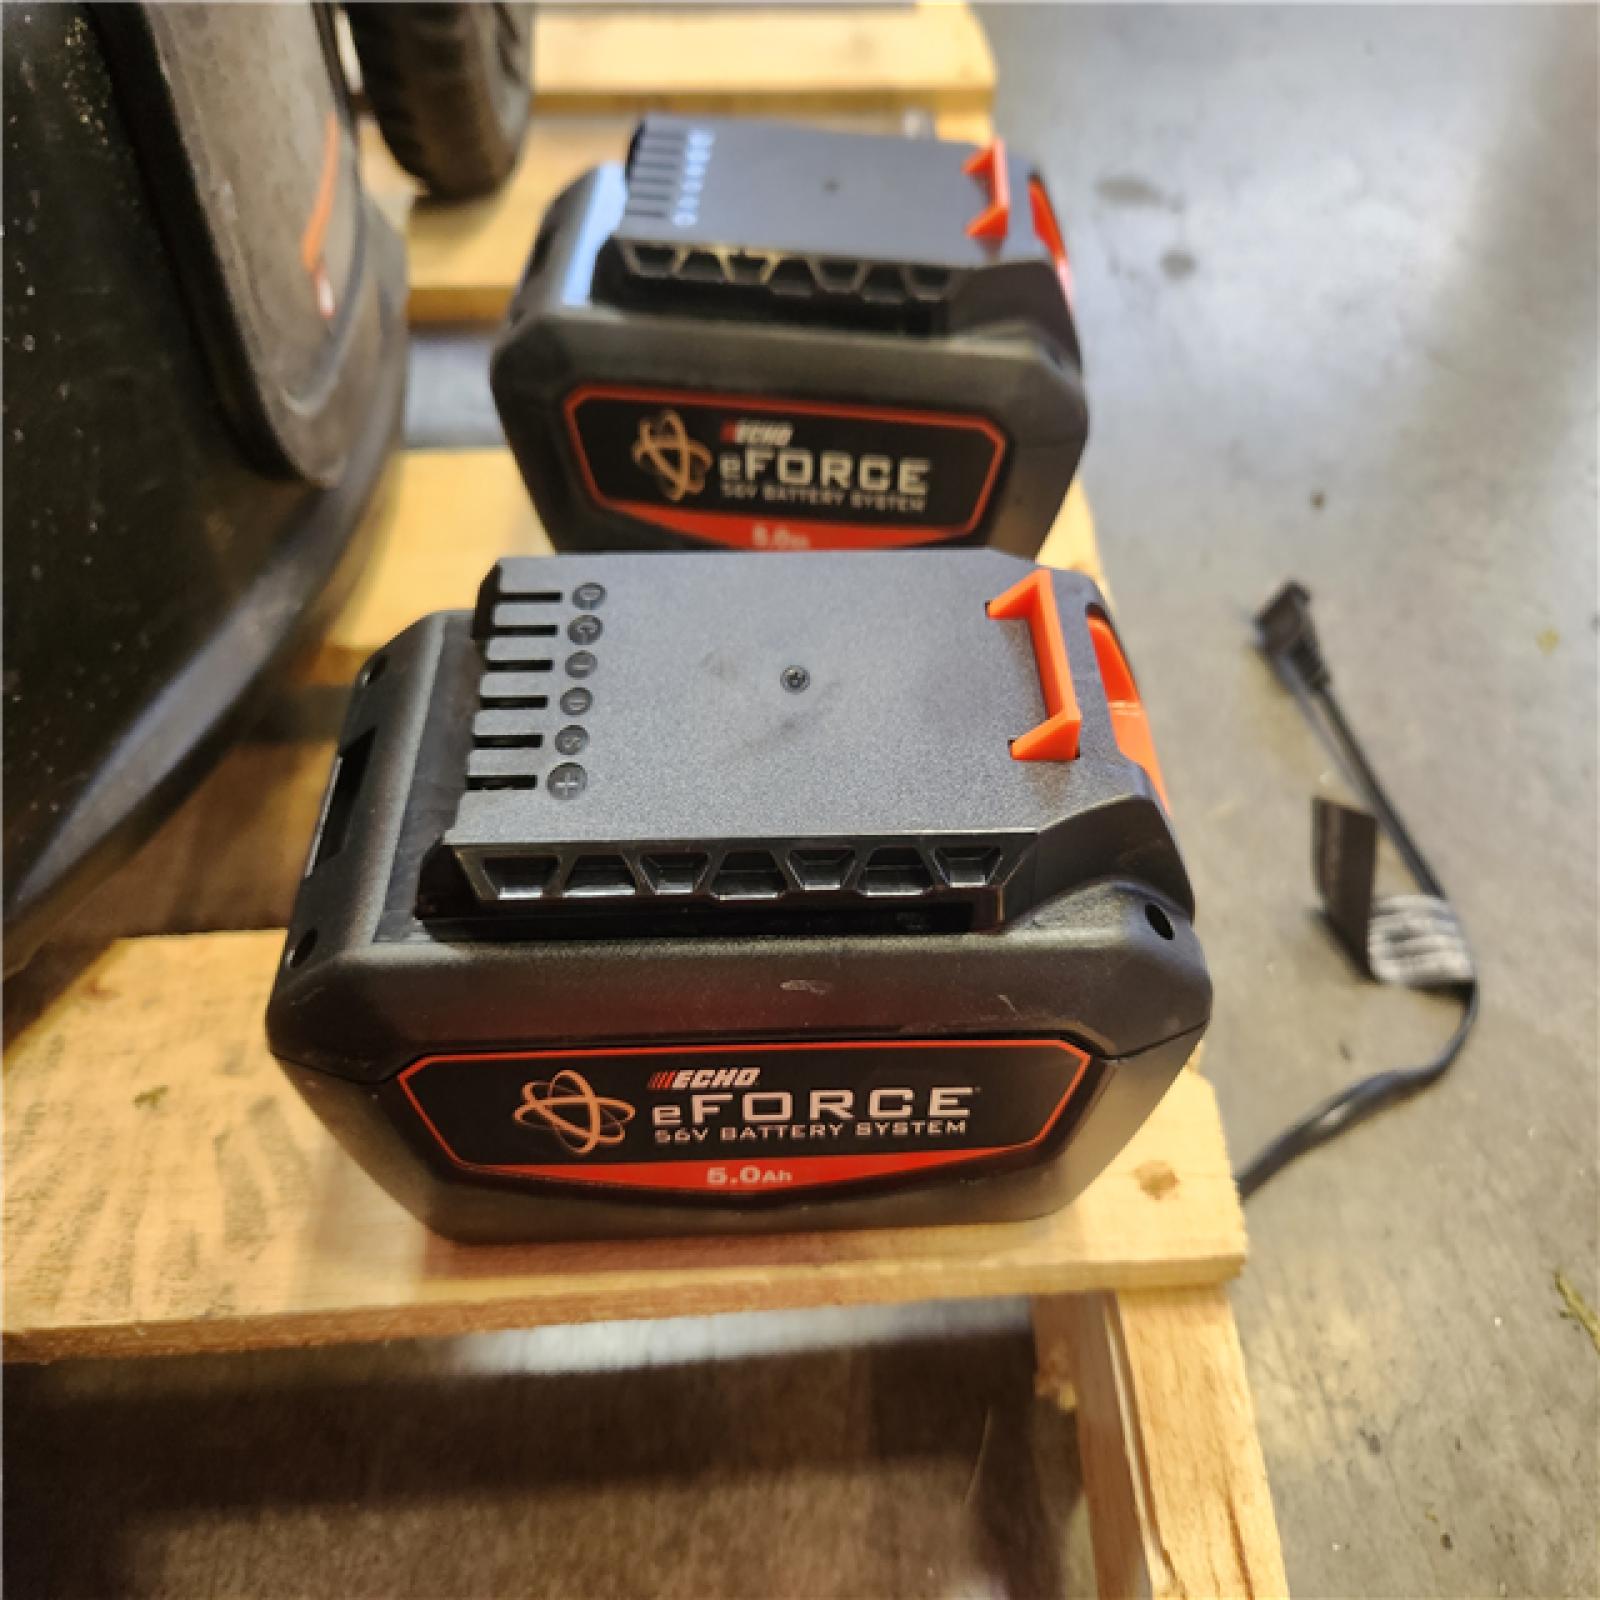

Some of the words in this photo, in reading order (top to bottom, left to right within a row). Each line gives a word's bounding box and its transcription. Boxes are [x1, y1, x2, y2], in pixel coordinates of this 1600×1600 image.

[719, 447, 930, 496] eFORCE
[672, 1068, 761, 1088] ECHO
[652, 1086, 974, 1126] eFORCE
[719, 1122, 843, 1142] BATTERY
[855, 1119, 967, 1137] SYSTEM
[706, 1165, 793, 1186] 5.0Ah
